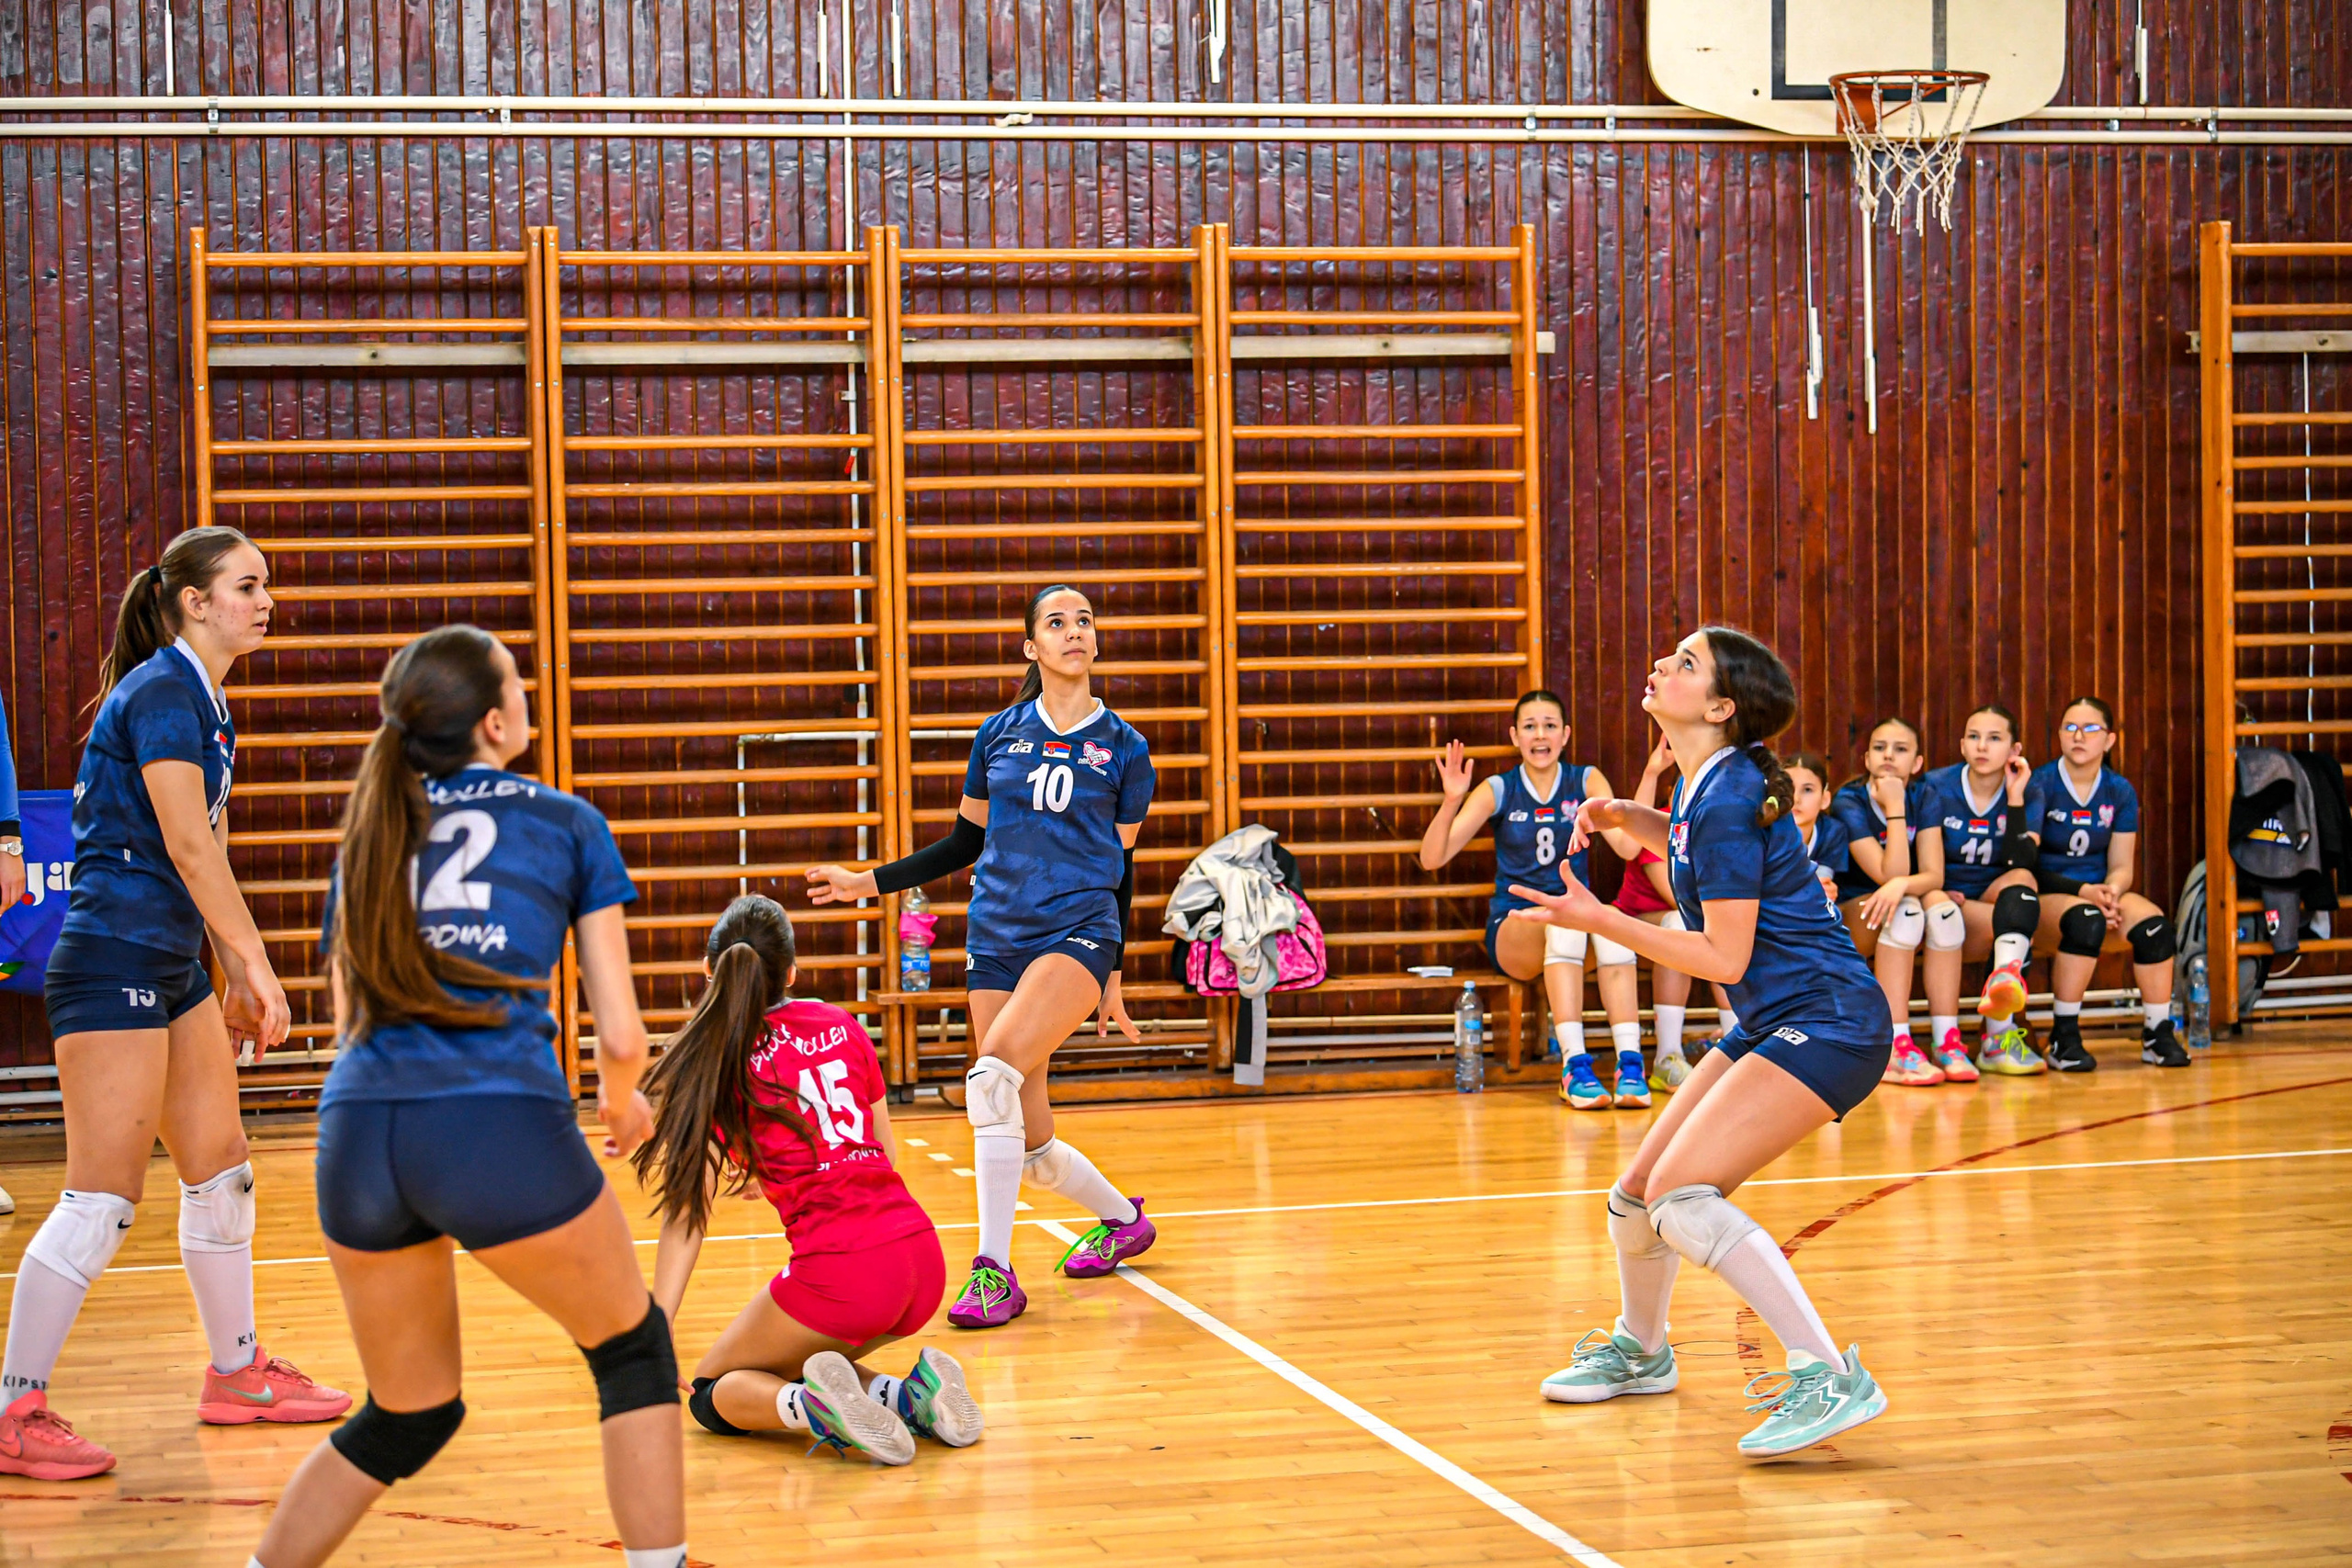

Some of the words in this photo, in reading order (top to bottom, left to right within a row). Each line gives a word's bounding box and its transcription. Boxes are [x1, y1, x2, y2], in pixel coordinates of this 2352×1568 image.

[1026, 762, 1074, 813] 10
[1535, 827, 1556, 866] 8
[1960, 837, 1993, 865] 11
[2066, 829, 2090, 857] 9
[789, 1025, 848, 1057] VOLLEY
[797, 1058, 865, 1150] 15
